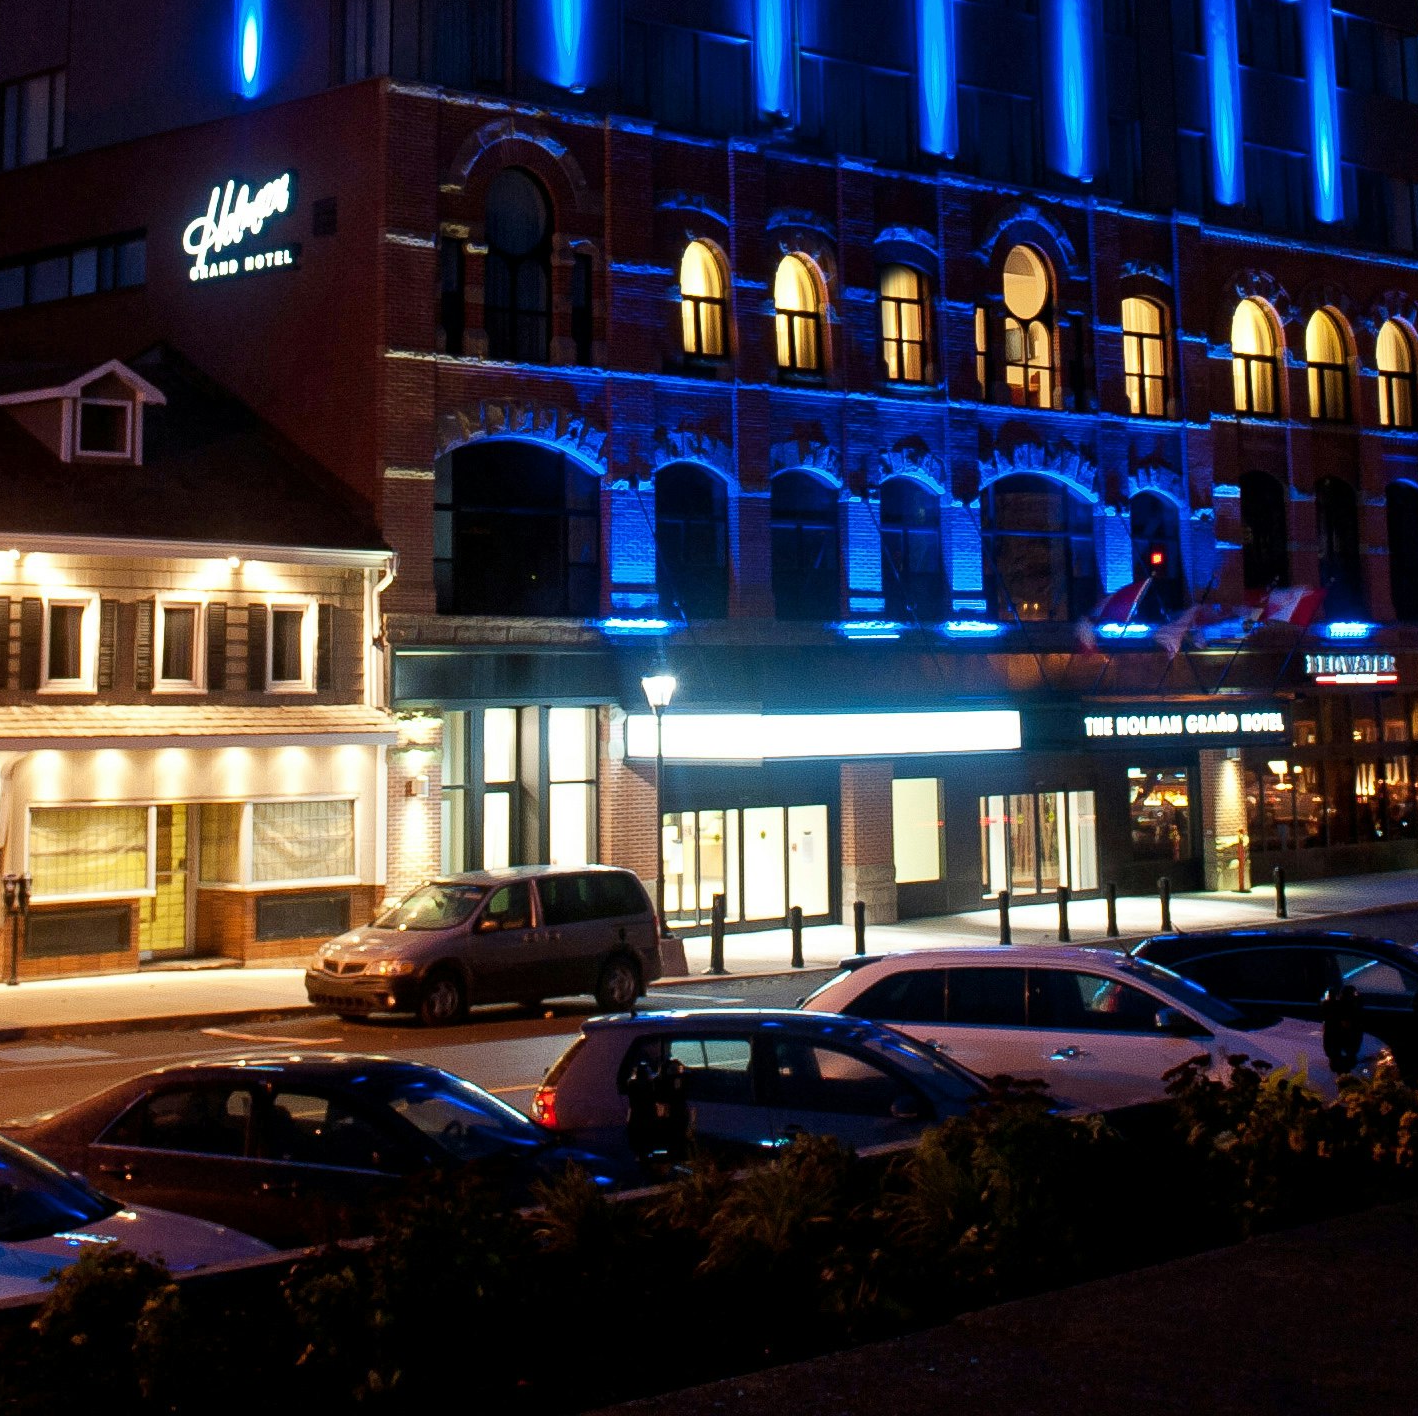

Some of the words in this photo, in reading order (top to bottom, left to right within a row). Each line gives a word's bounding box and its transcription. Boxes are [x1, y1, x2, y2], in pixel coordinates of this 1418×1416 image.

[189, 259, 239, 282] GRAND
[244, 249, 293, 272] HOTEL
[1084, 716, 1114, 737] THE
[1116, 715, 1183, 736] HOLMAN
[1185, 713, 1239, 734] GRAND
[1240, 712, 1285, 732] HOTEL
